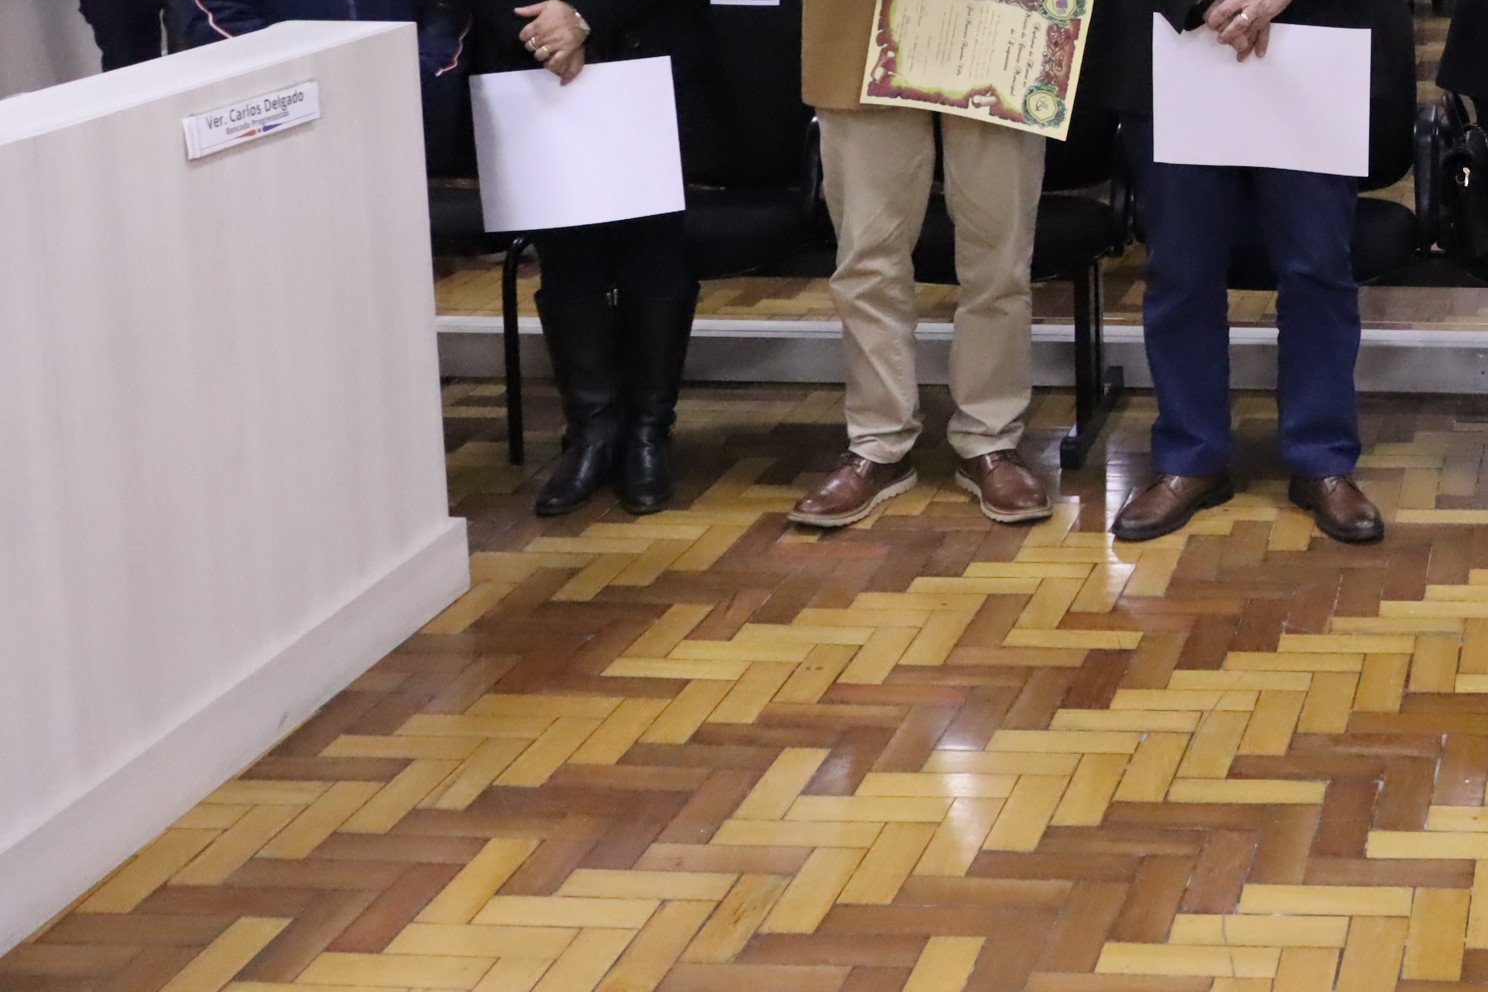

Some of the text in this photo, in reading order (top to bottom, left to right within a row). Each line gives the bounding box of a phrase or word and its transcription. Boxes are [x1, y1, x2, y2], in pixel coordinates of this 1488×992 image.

[205, 90, 304, 130] Ver. Carlos Delgado
